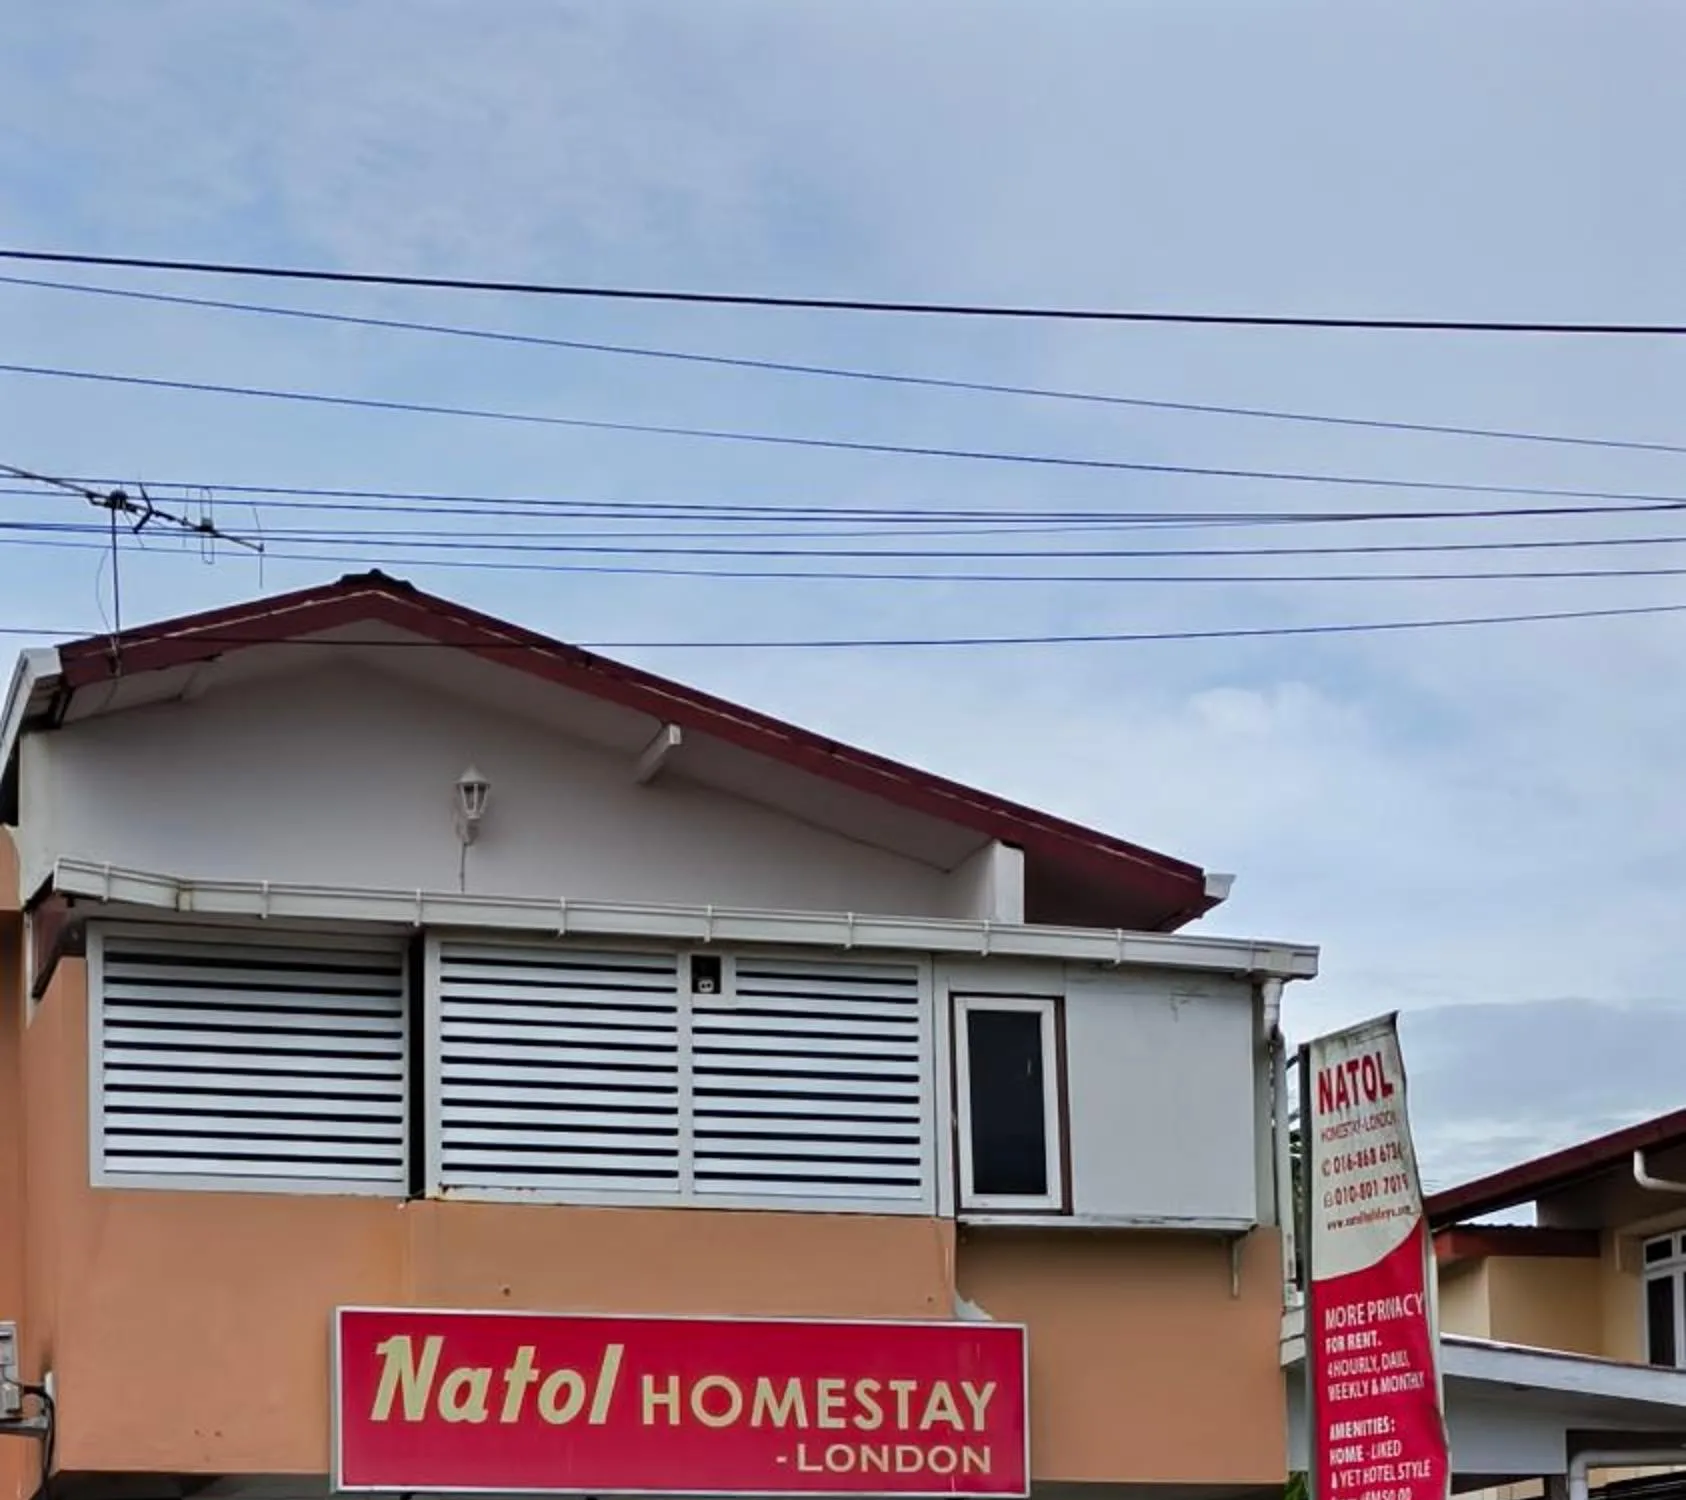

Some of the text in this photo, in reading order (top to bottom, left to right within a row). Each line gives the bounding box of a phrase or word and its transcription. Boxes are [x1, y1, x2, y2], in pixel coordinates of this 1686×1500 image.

[1317, 1051, 1394, 1115] NATOL
[1325, 1303, 1365, 1330] MORE
[1325, 1335, 1345, 1354] FOR
[371, 1335, 996, 1431] Natol HOMESTAY
[1328, 1378, 1369, 1402] WEEKLY
[1371, 1377, 1379, 1395] &
[1329, 1444, 1364, 1466] HOME
[1339, 1469, 1361, 1488] YET
[1363, 1463, 1396, 1485] HOTEL
[1398, 1459, 1431, 1480] STYLE
